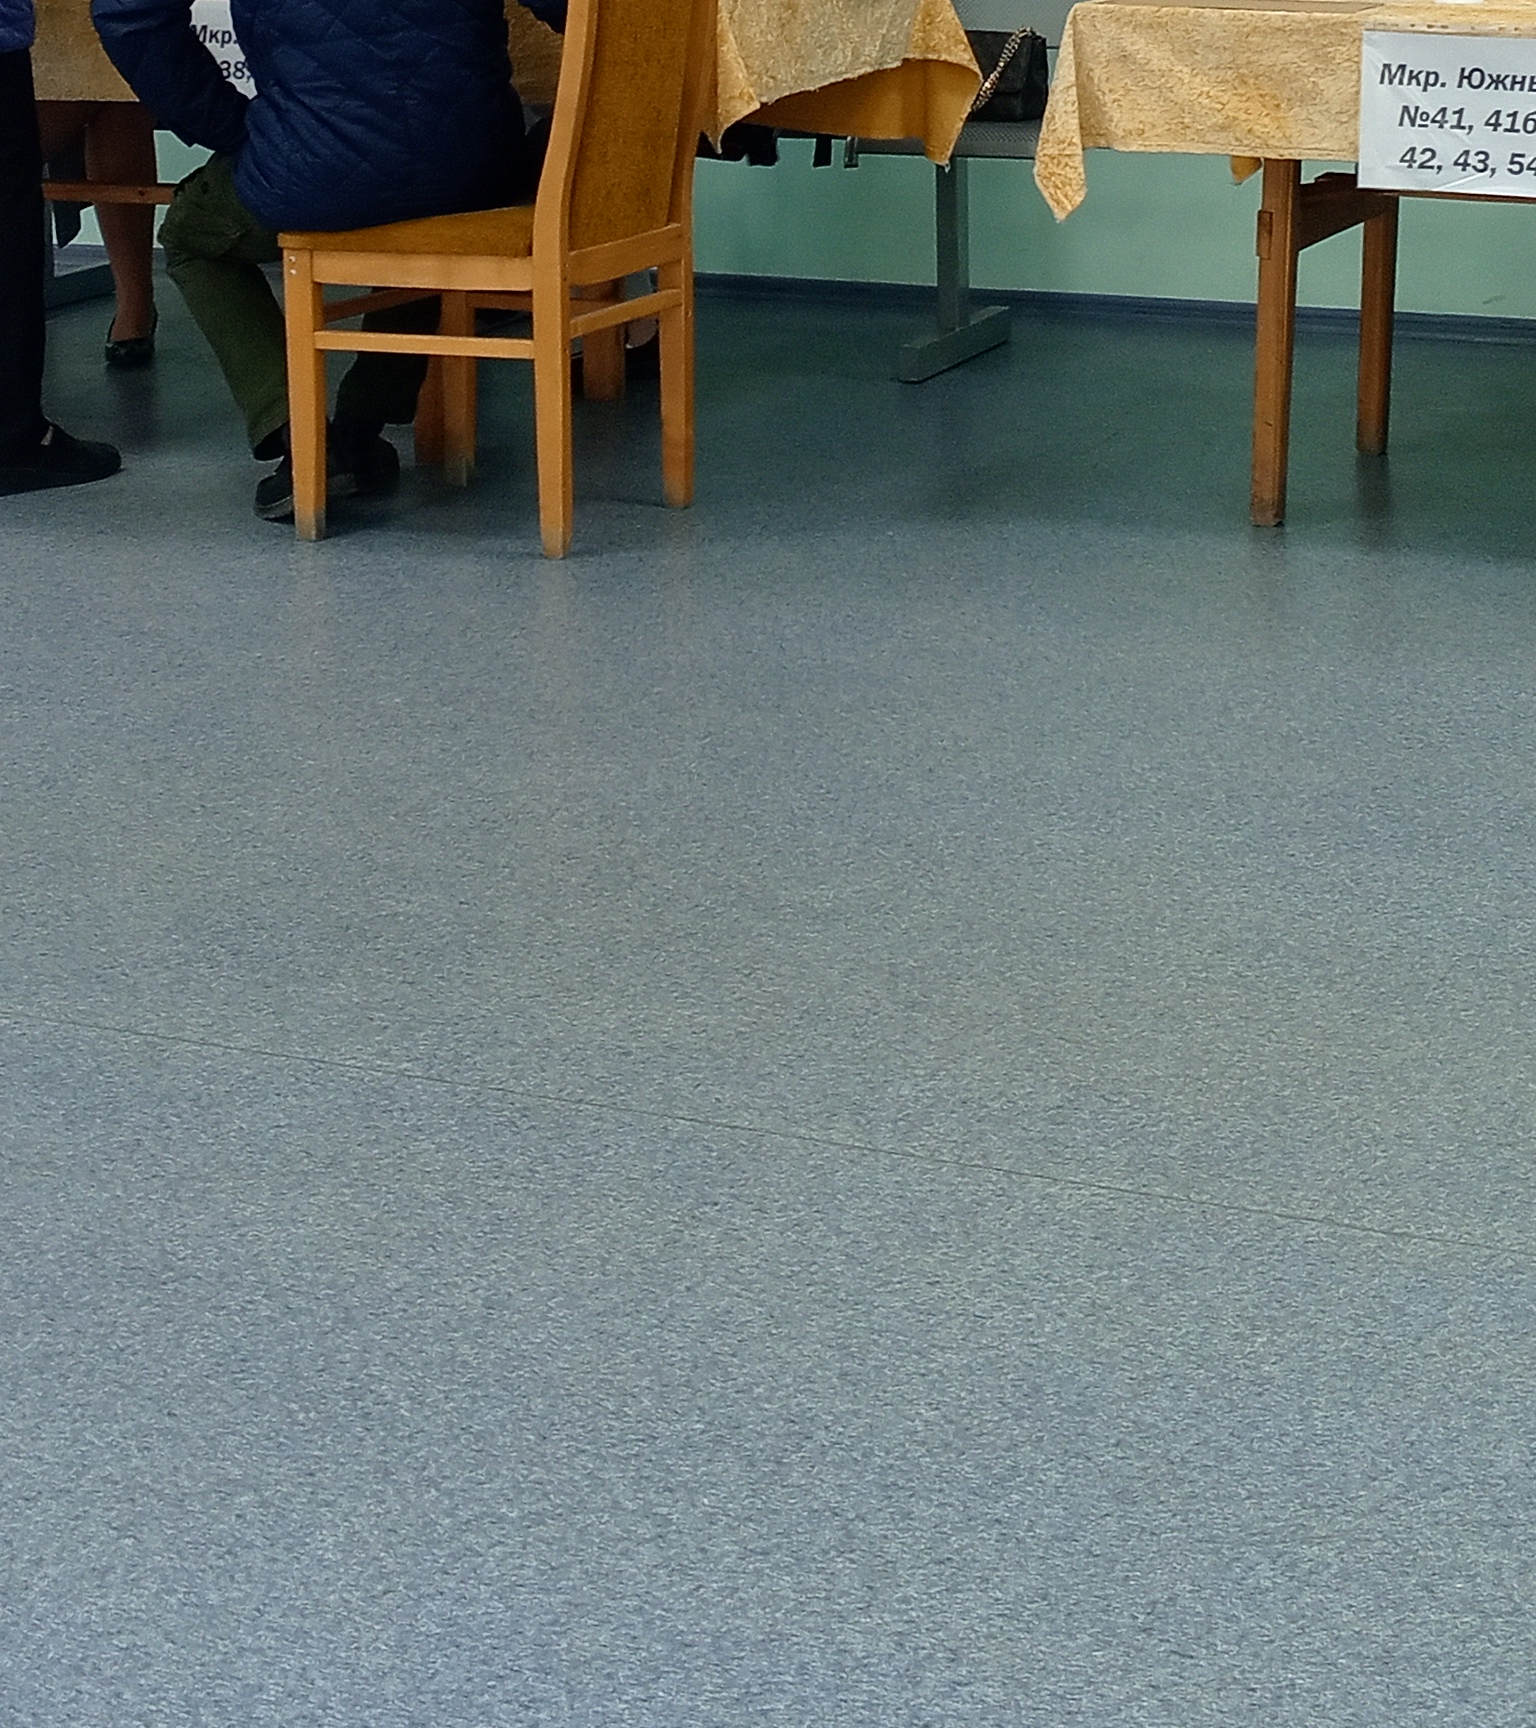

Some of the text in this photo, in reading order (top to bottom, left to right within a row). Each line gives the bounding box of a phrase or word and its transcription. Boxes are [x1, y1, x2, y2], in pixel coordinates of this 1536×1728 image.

[1379, 63, 1447, 92] Мкр.
[1398, 105, 1474, 135] №41,
[1399, 146, 1443, 174] 42,
[1454, 150, 1497, 178] 43,
